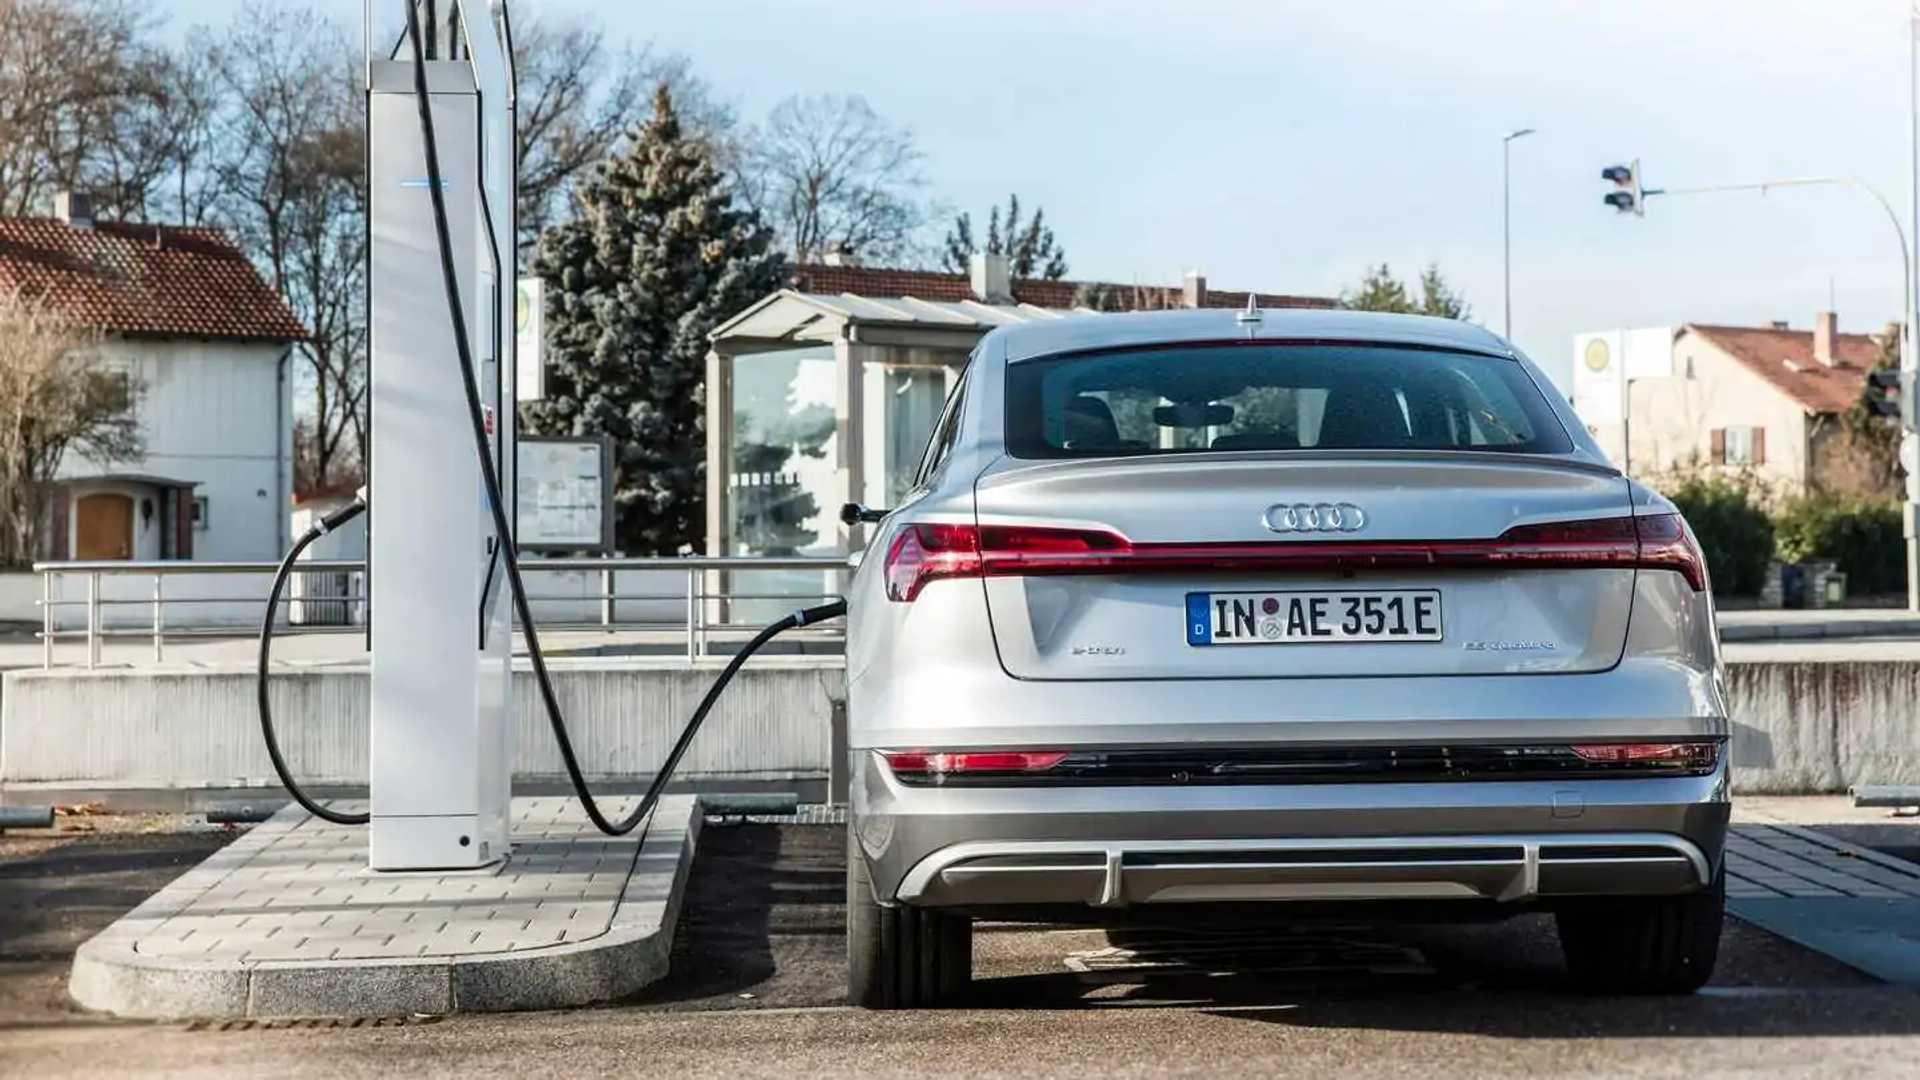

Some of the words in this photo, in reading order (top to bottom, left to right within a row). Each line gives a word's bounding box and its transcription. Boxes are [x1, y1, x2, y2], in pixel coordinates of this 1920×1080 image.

[1195, 624, 1204, 635] D
[1215, 599, 1256, 637] IN
[1287, 598, 1331, 636] AE
[1341, 597, 1437, 635] 351E
